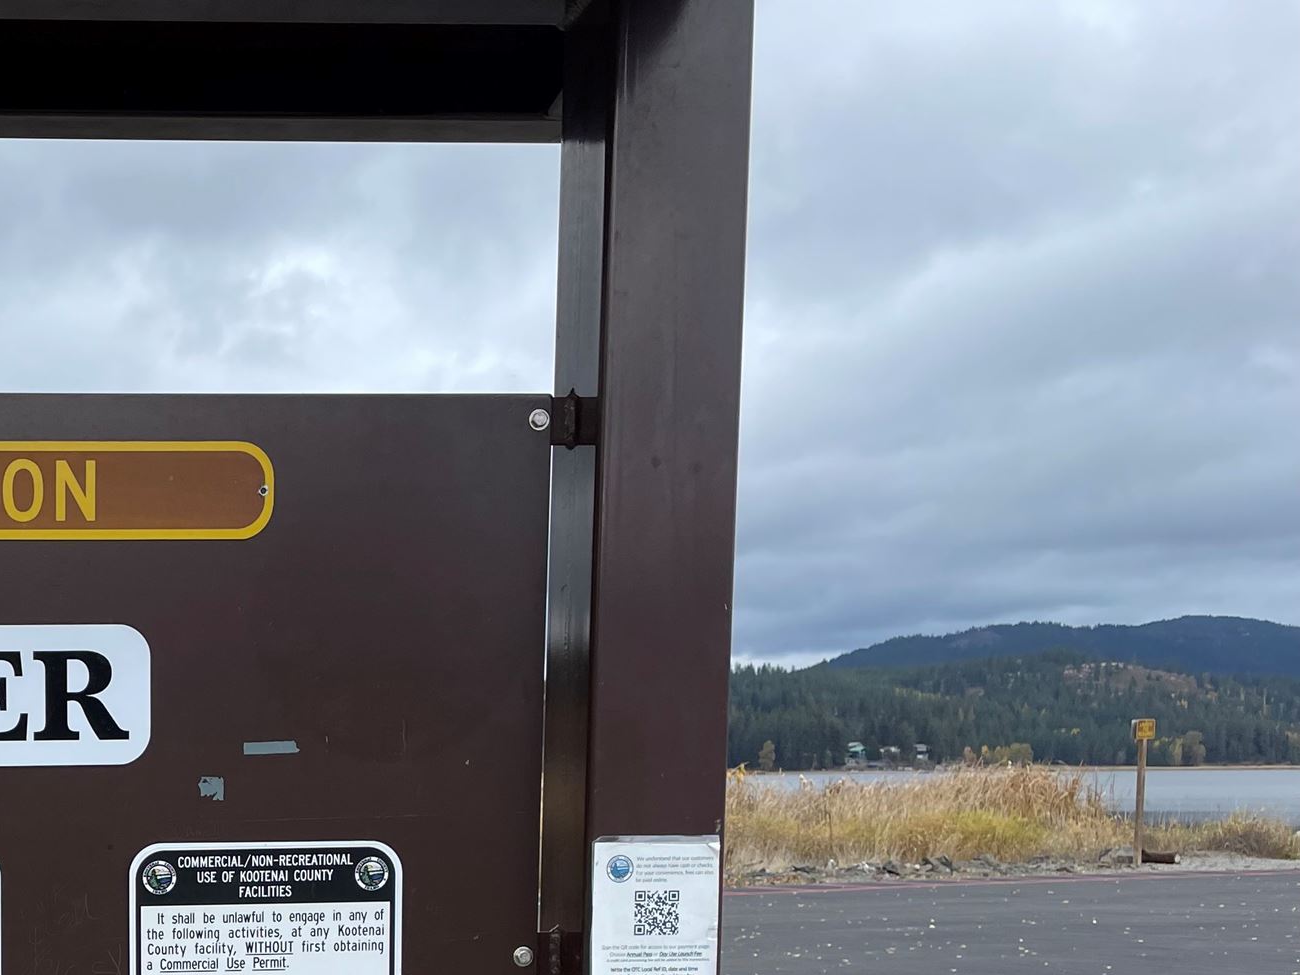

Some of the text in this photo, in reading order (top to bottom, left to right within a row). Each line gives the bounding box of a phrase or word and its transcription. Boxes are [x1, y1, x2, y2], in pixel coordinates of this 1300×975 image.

[177, 852, 354, 869] COMMERCIAL/NON-RECREATIONAL
[196, 867, 334, 886] USE OF KOOTENAI COUNTY
[238, 884, 293, 899] FACILITIES
[157, 908, 385, 926] It shall be unlawful to engage in any of
[146, 923, 385, 942] the following activities, at any Kootenai
